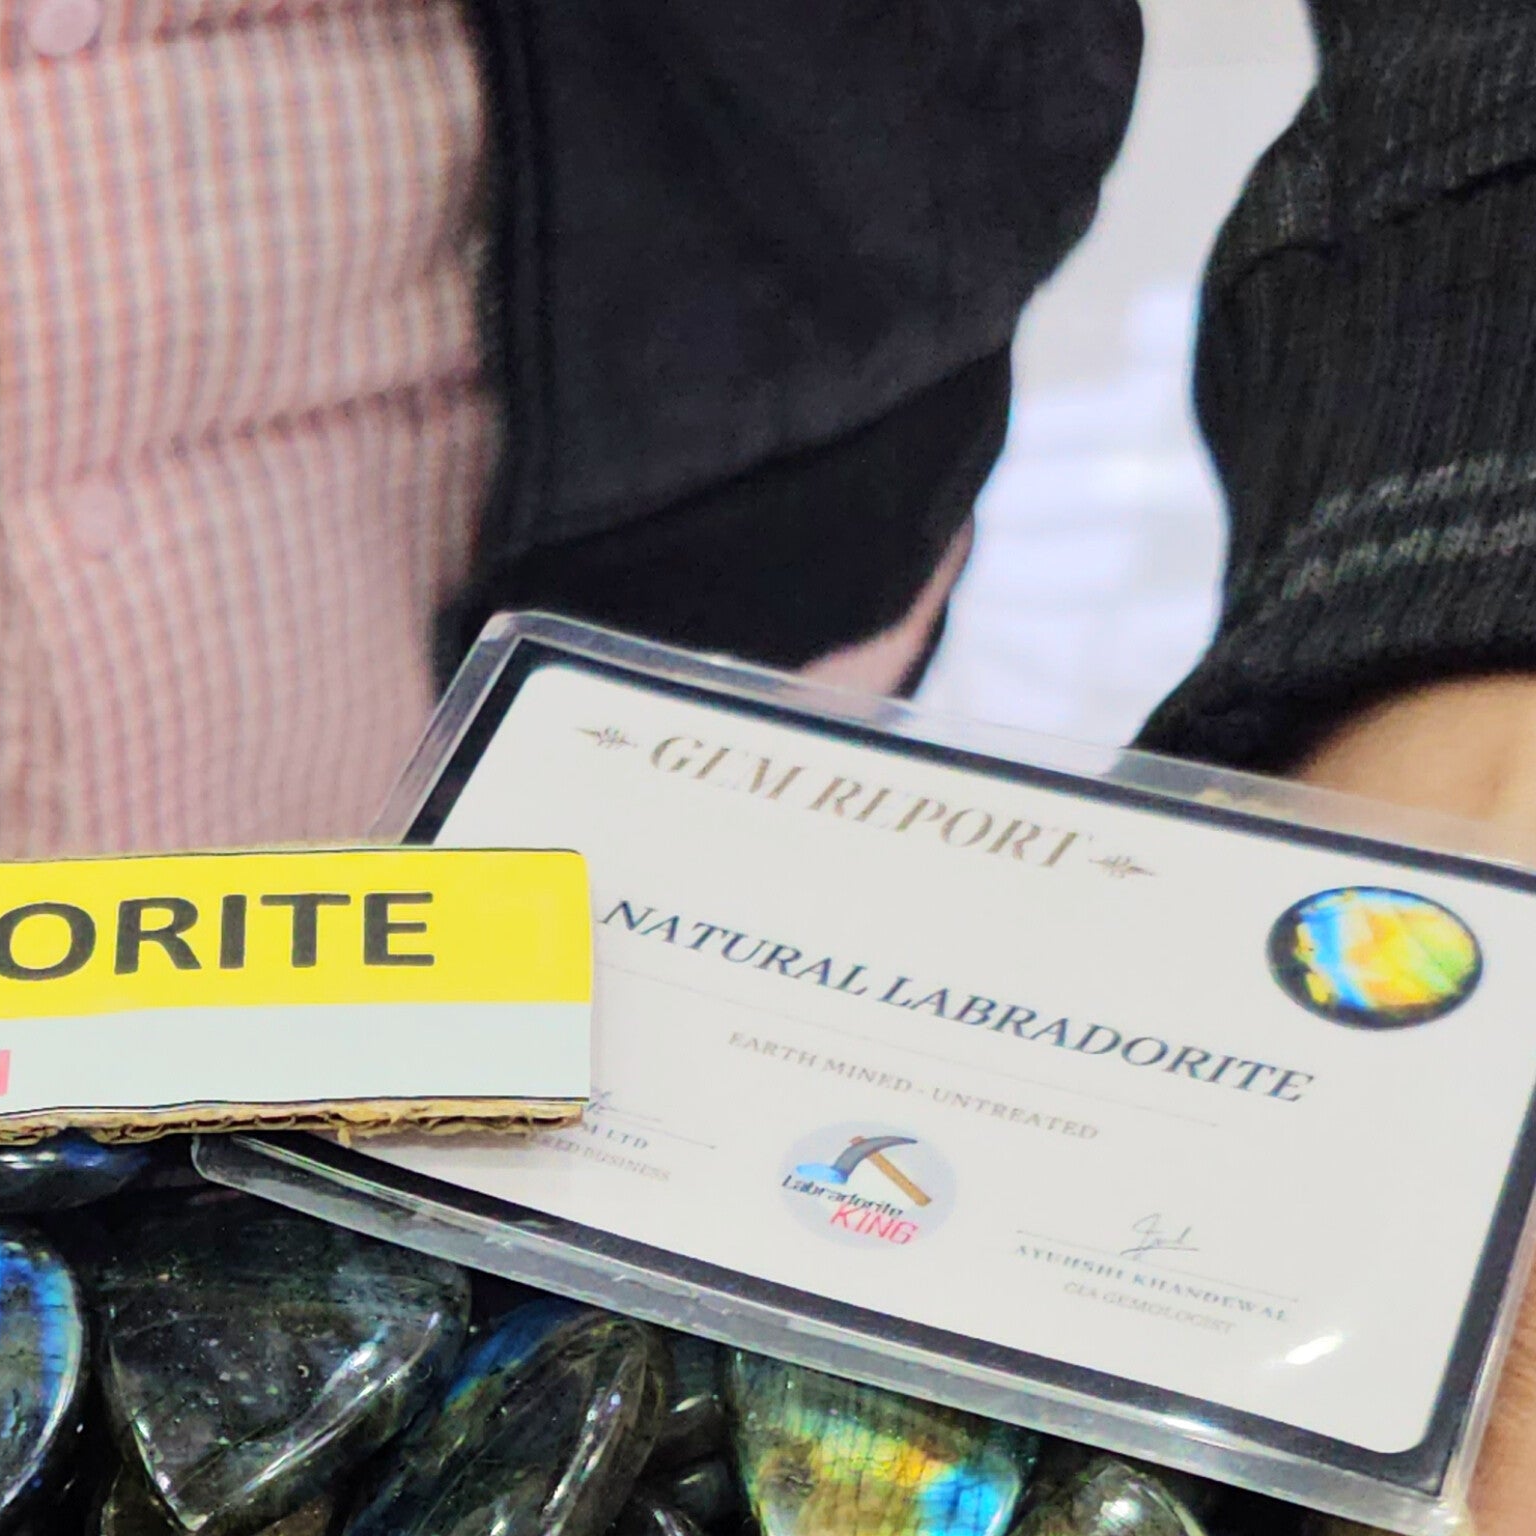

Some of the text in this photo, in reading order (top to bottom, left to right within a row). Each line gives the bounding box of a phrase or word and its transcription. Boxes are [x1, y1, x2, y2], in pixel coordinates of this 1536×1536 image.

[650, 736, 1094, 867] GEM REPORT
[598, 899, 1315, 1103] NATURAL LABRADORITE
[728, 1030, 819, 1068] EARTH
[822, 1057, 914, 1094] MINED
[931, 1086, 1100, 1141] UNTREATED
[605, 1128, 649, 1150] LTD
[781, 1174, 904, 1217] Labradorite
[829, 1202, 920, 1245] KING
[1102, 1290, 1237, 1336] GEMOLOGIST
